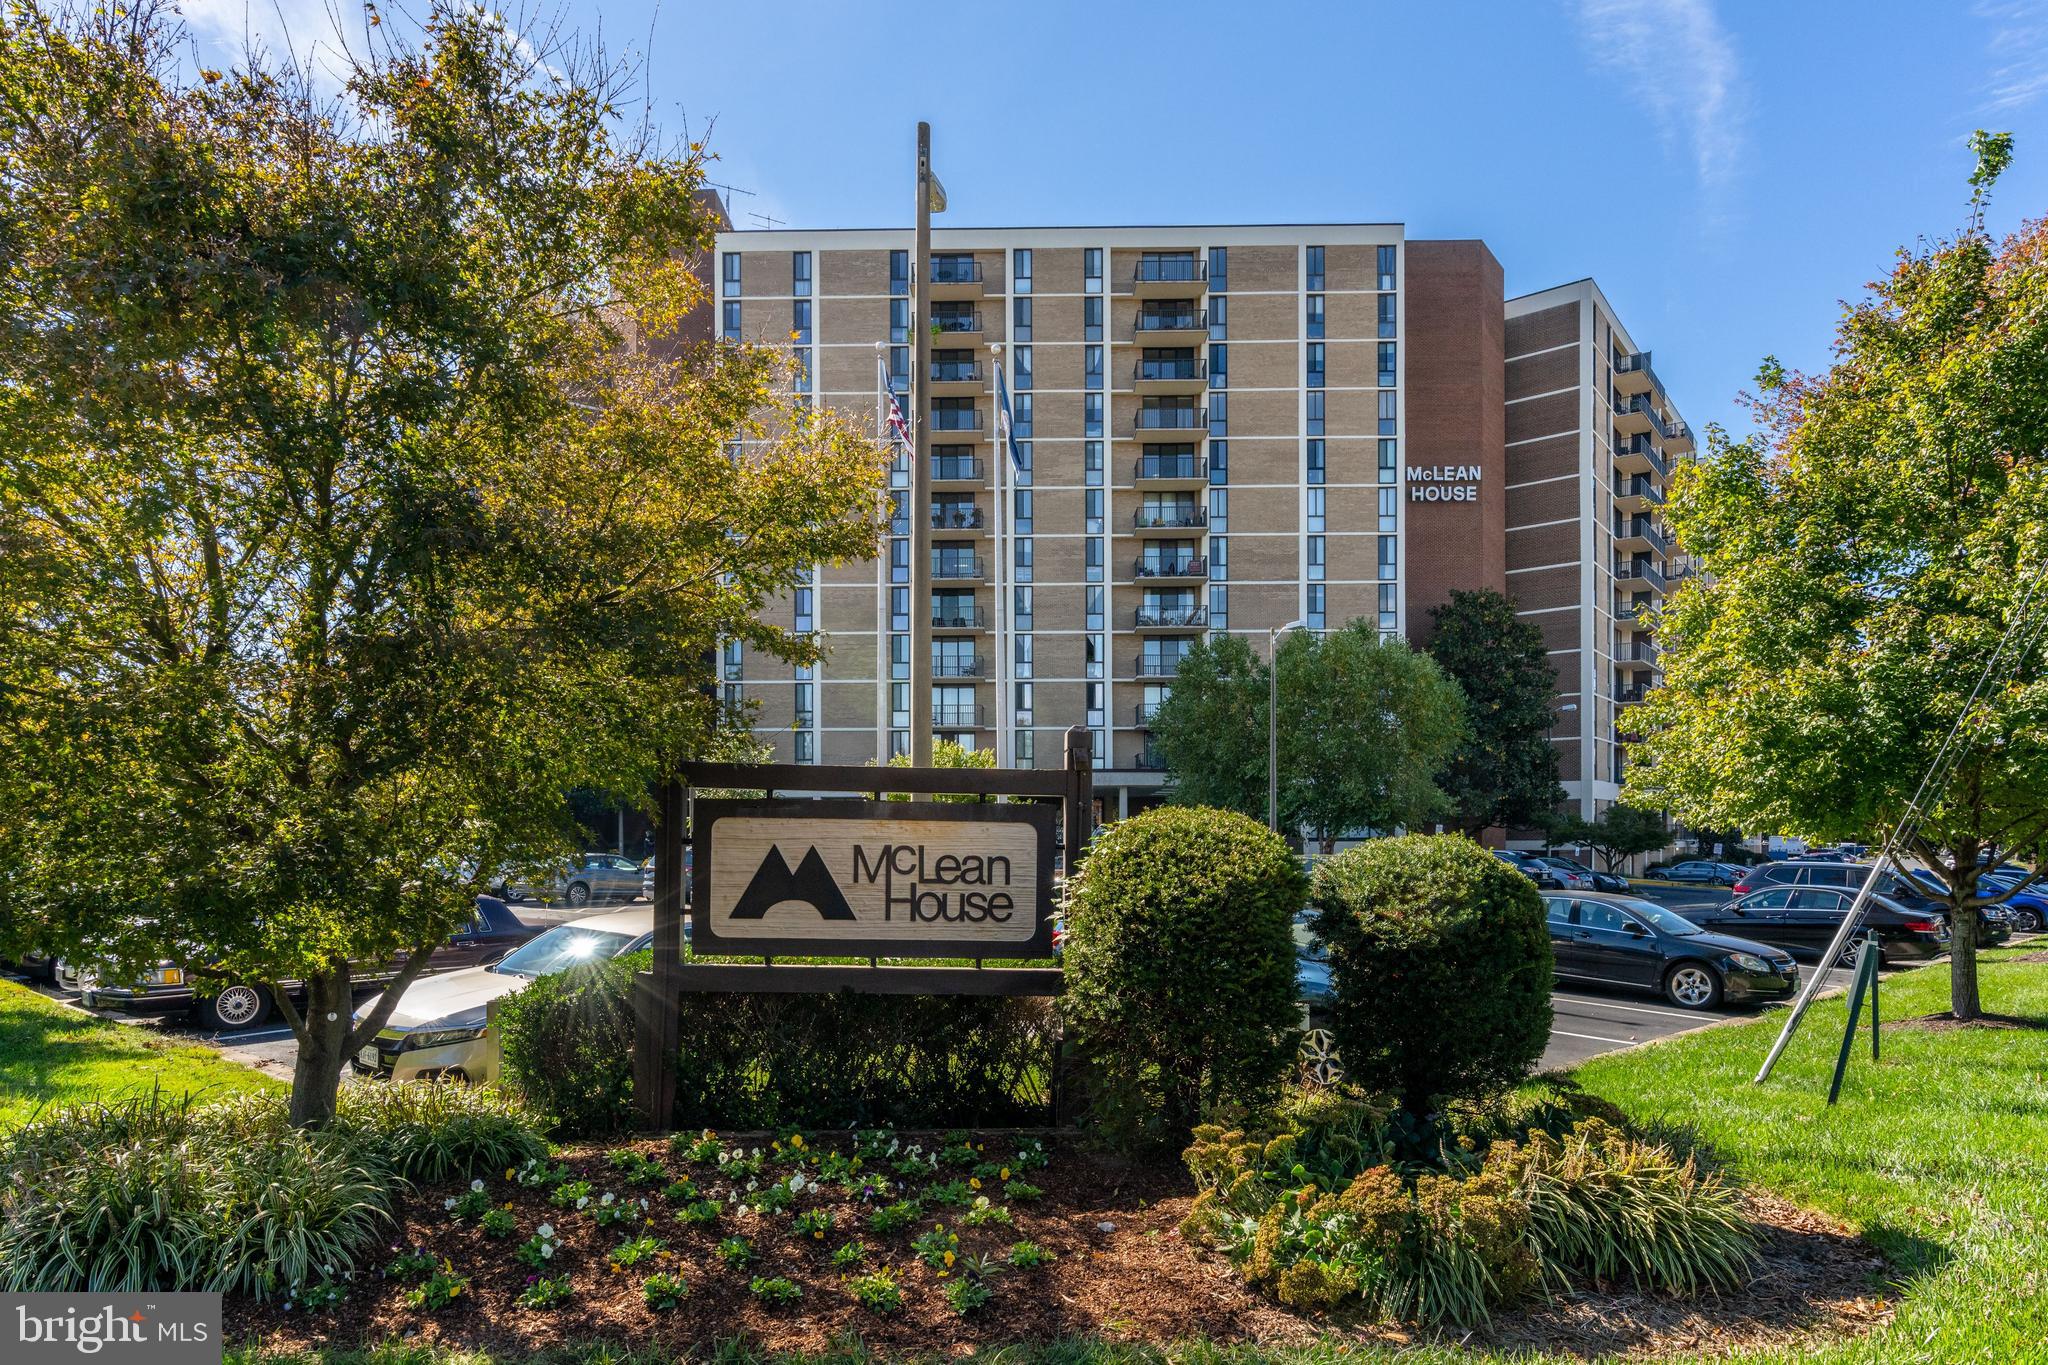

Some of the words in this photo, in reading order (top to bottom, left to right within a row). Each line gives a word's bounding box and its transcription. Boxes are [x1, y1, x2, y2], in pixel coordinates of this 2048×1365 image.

[1407, 466, 1481, 481] McLEAN
[1411, 486, 1477, 501] HOUSE
[853, 844, 1011, 885] McLean
[885, 882, 1014, 922] House
